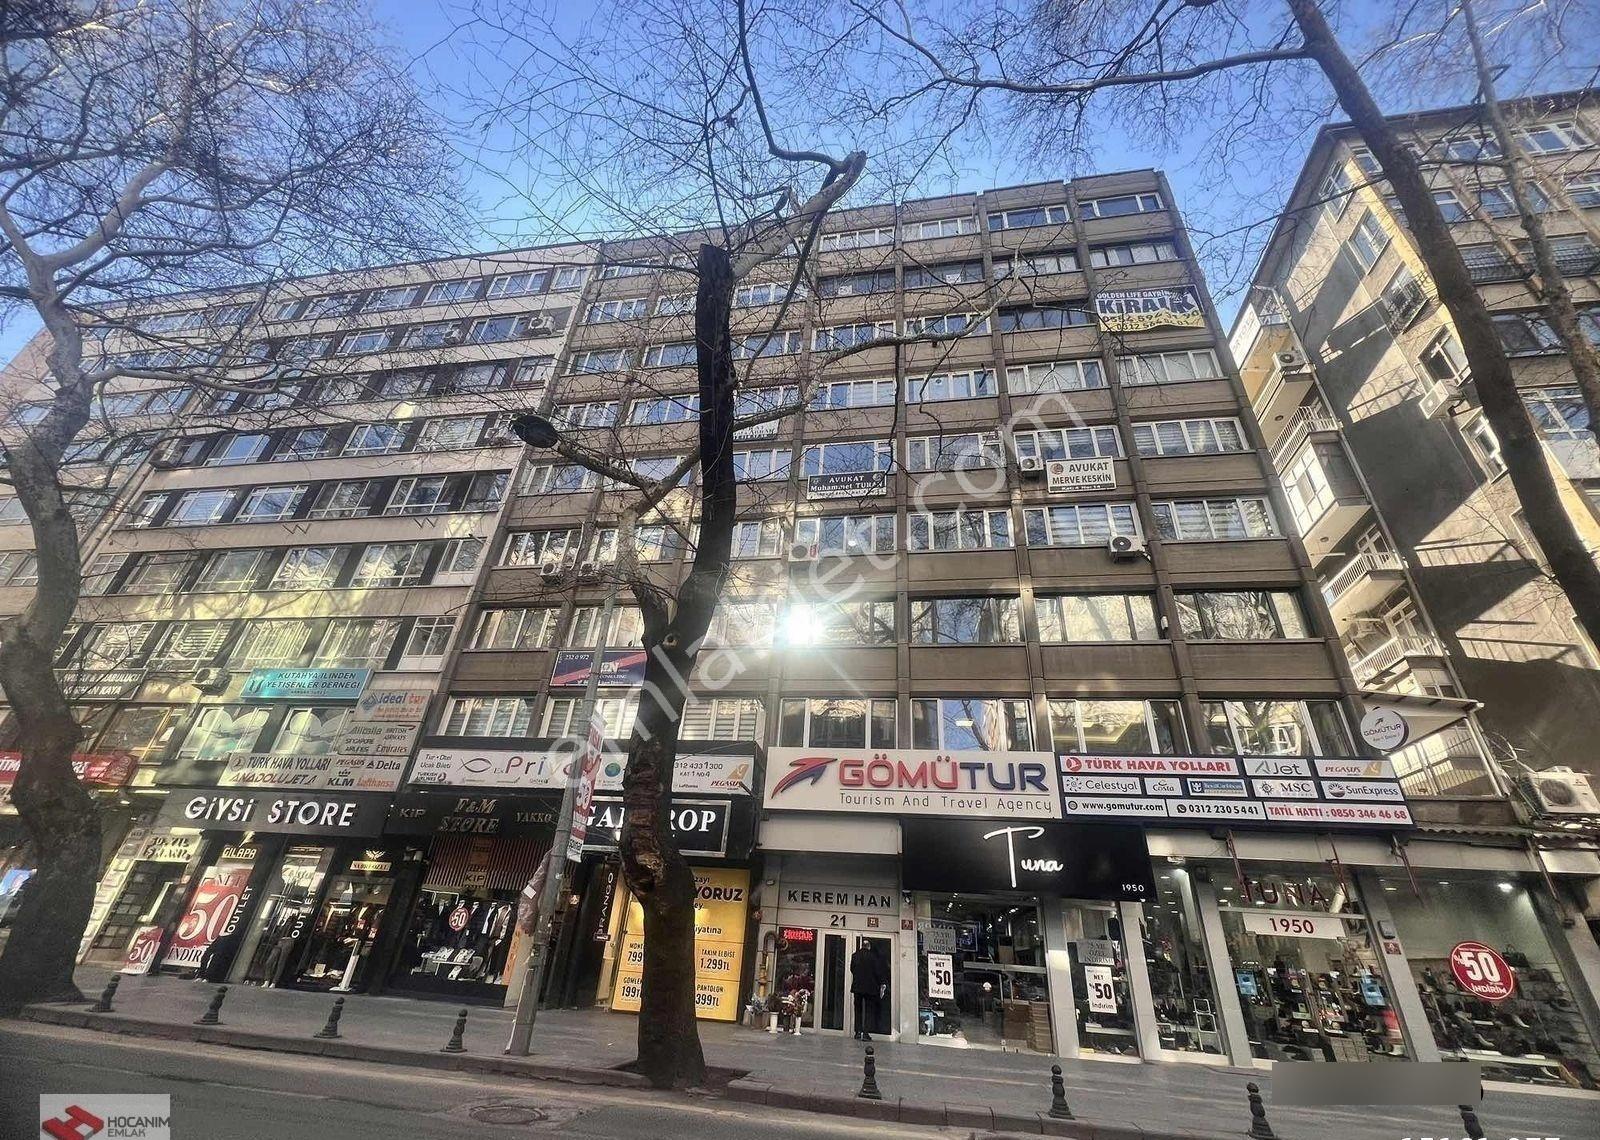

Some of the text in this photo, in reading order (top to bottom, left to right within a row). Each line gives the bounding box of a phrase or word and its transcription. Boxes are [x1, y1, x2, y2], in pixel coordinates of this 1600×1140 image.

[1069, 462, 1109, 472] AVUKAT
[829, 475, 865, 484] AVUKAT
[1052, 473, 1112, 485] MERVE KESKİN
[99, 685, 122, 695] KAYA
[380, 692, 408, 704] ideal
[270, 757, 294, 770] HAVA
[294, 757, 332, 771] YOLLARI
[375, 760, 400, 770] Delta
[1085, 757, 1232, 772] TÜRK HAVA YOLLARI
[1325, 766, 1361, 774] PEGASUS
[838, 753, 1049, 792] GÖMÜTUR
[327, 777, 355, 787] KLM
[1085, 779, 1138, 793] Celestyal
[1152, 784, 1175, 792] Costa
[1280, 782, 1312, 793] MSC
[1346, 785, 1399, 797] SunExpress
[840, 792, 1052, 814] Tourism And Travel Agency
[1082, 801, 1164, 812] www.gomutur.com
[1188, 805, 1212, 814] 0312
[1214, 805, 1232, 814] 230
[184, 796, 357, 827] GİYSİ STORE
[1268, 804, 1294, 816] TATİL
[1297, 807, 1323, 817] HATTI
[1331, 808, 1355, 819] 0850
[1358, 809, 1376, 819] 346
[1379, 810, 1391, 820] 46
[1394, 810, 1408, 820] 68
[439, 816, 500, 833] STORE
[983, 826, 1064, 888] Tuna
[694, 876, 710, 886] zayı
[1121, 883, 1145, 892] 1950
[695, 885, 744, 902] YORUZ
[787, 889, 891, 908] KEREM HAN
[226, 885, 253, 934] OUTLET
[178, 892, 240, 943] 50
[830, 914, 847, 928] 21
[695, 926, 722, 935] iyatına
[1269, 917, 1315, 935] 1950
[129, 939, 155, 965] 50
[166, 943, 203, 963] İNDİR
[627, 951, 643, 963] 799
[700, 957, 731, 970] 1.299TL
[696, 984, 725, 993] PANTOLON
[695, 993, 720, 1007] 399TL
